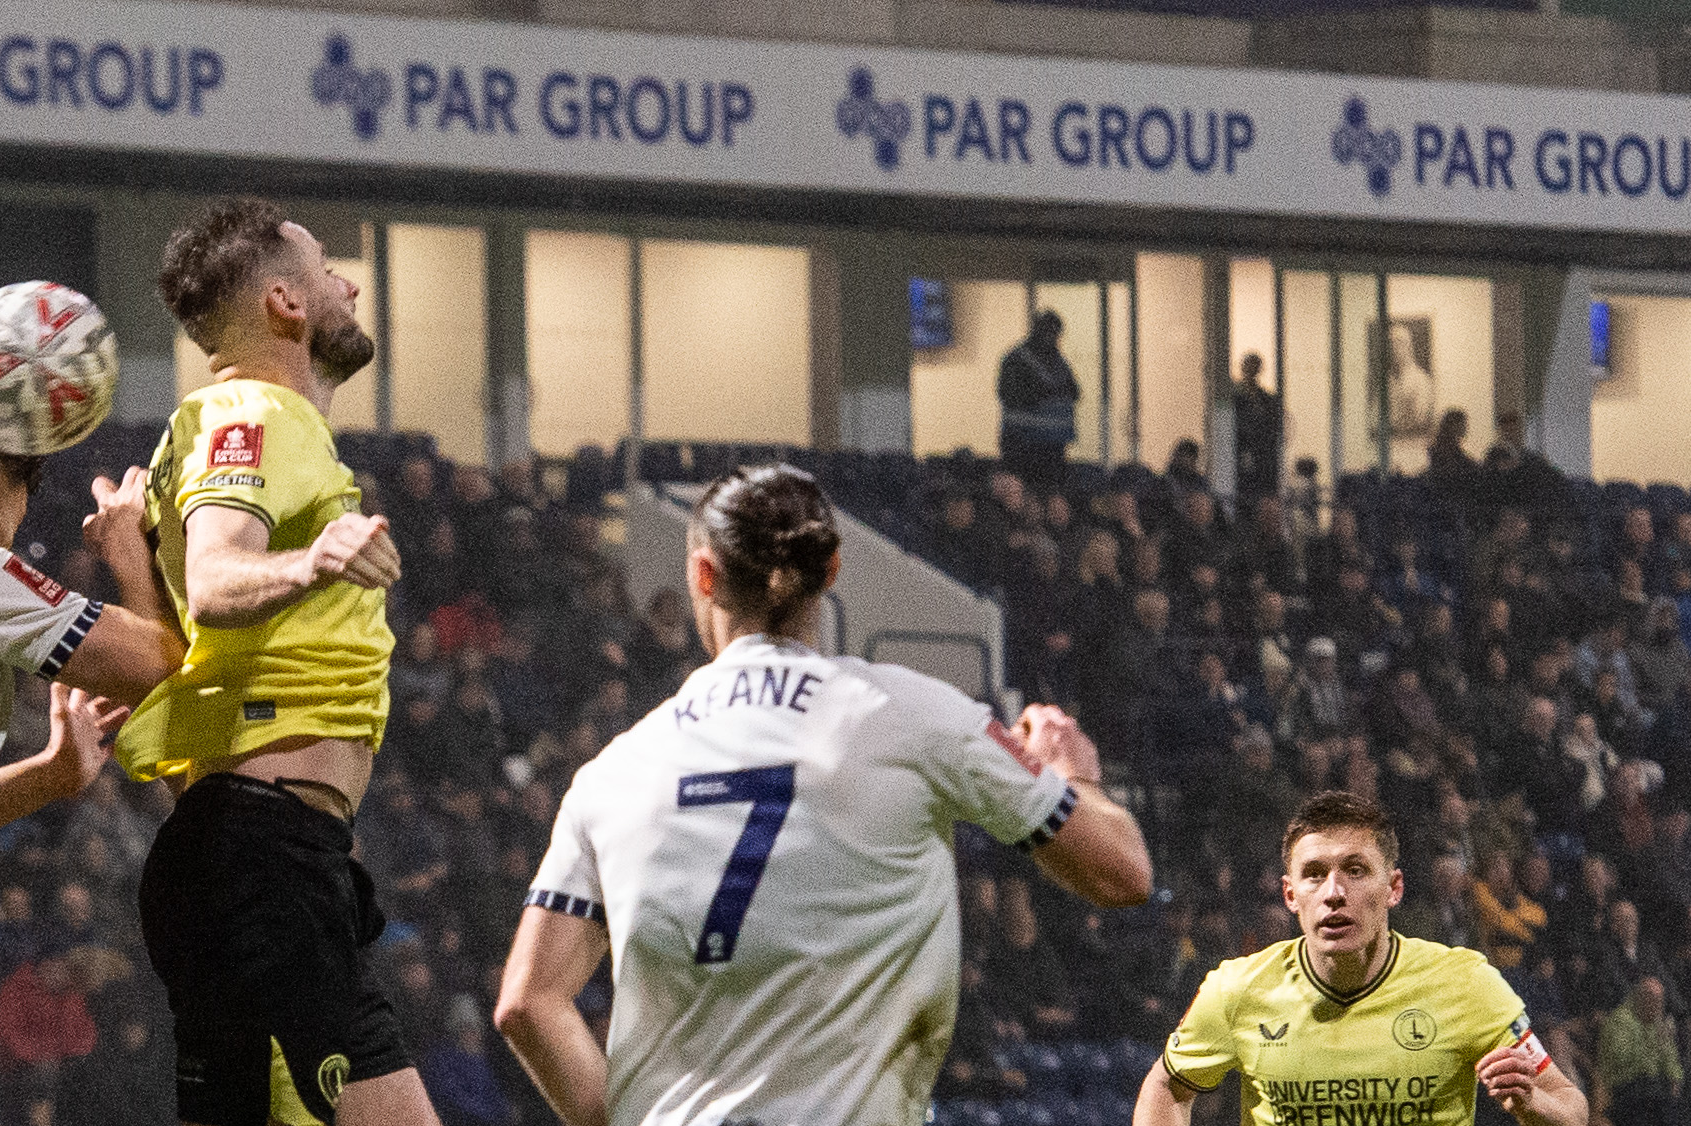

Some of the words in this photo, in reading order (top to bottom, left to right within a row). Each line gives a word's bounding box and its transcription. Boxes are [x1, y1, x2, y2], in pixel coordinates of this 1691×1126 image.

[404, 62, 521, 137] PAR
[538, 70, 755, 148] GROUP
[922, 93, 1033, 165] PAR
[1050, 101, 1255, 175] GROUP
[1413, 122, 1516, 190] PAR
[228, 453, 254, 462] CUP
[673, 665, 823, 732] KEANE
[677, 763, 796, 965] 7
[1262, 1077, 1401, 1103] UNIVERSITY
[1407, 1075, 1440, 1099] OF
